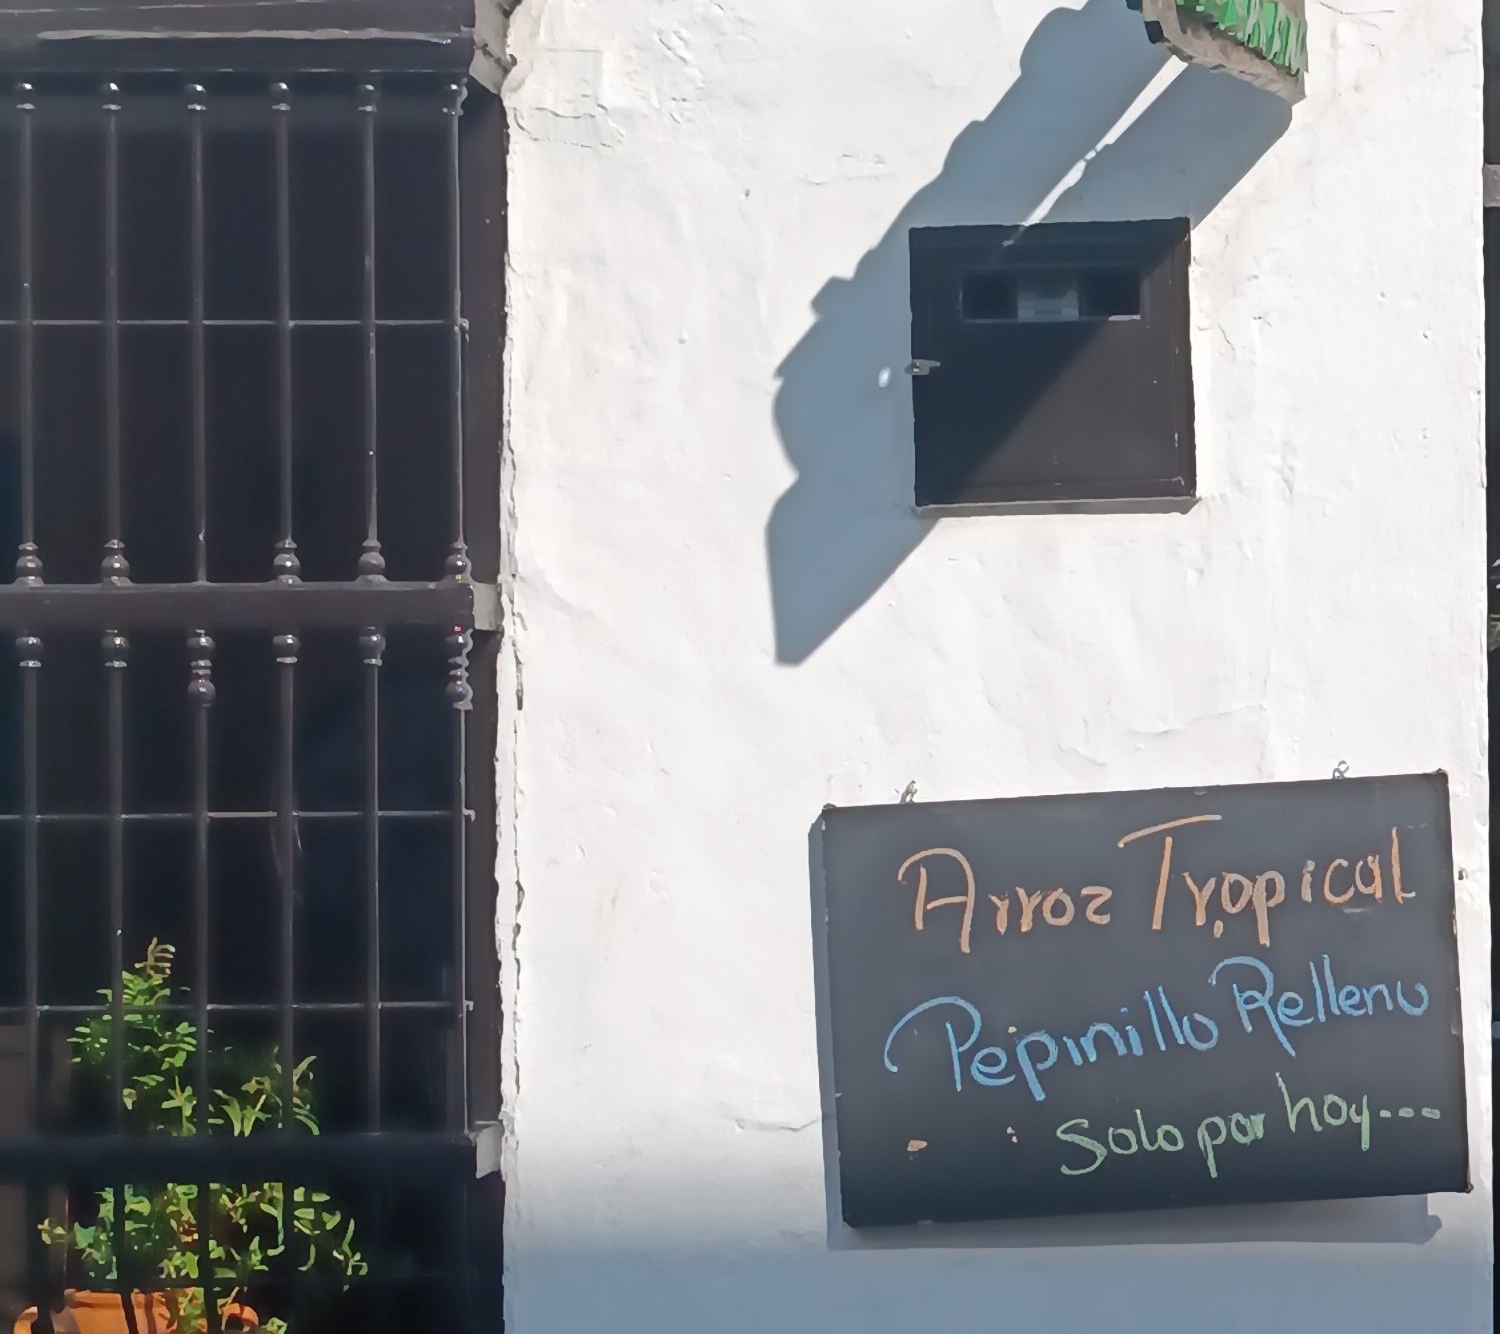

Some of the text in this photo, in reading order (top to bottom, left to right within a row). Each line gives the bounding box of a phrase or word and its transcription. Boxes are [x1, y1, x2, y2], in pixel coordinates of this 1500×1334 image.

[898, 814, 1416, 954] Arroz Tropical
[884, 985, 1219, 1101] Pepinillo
[1056, 1108, 1184, 1176] Solo
